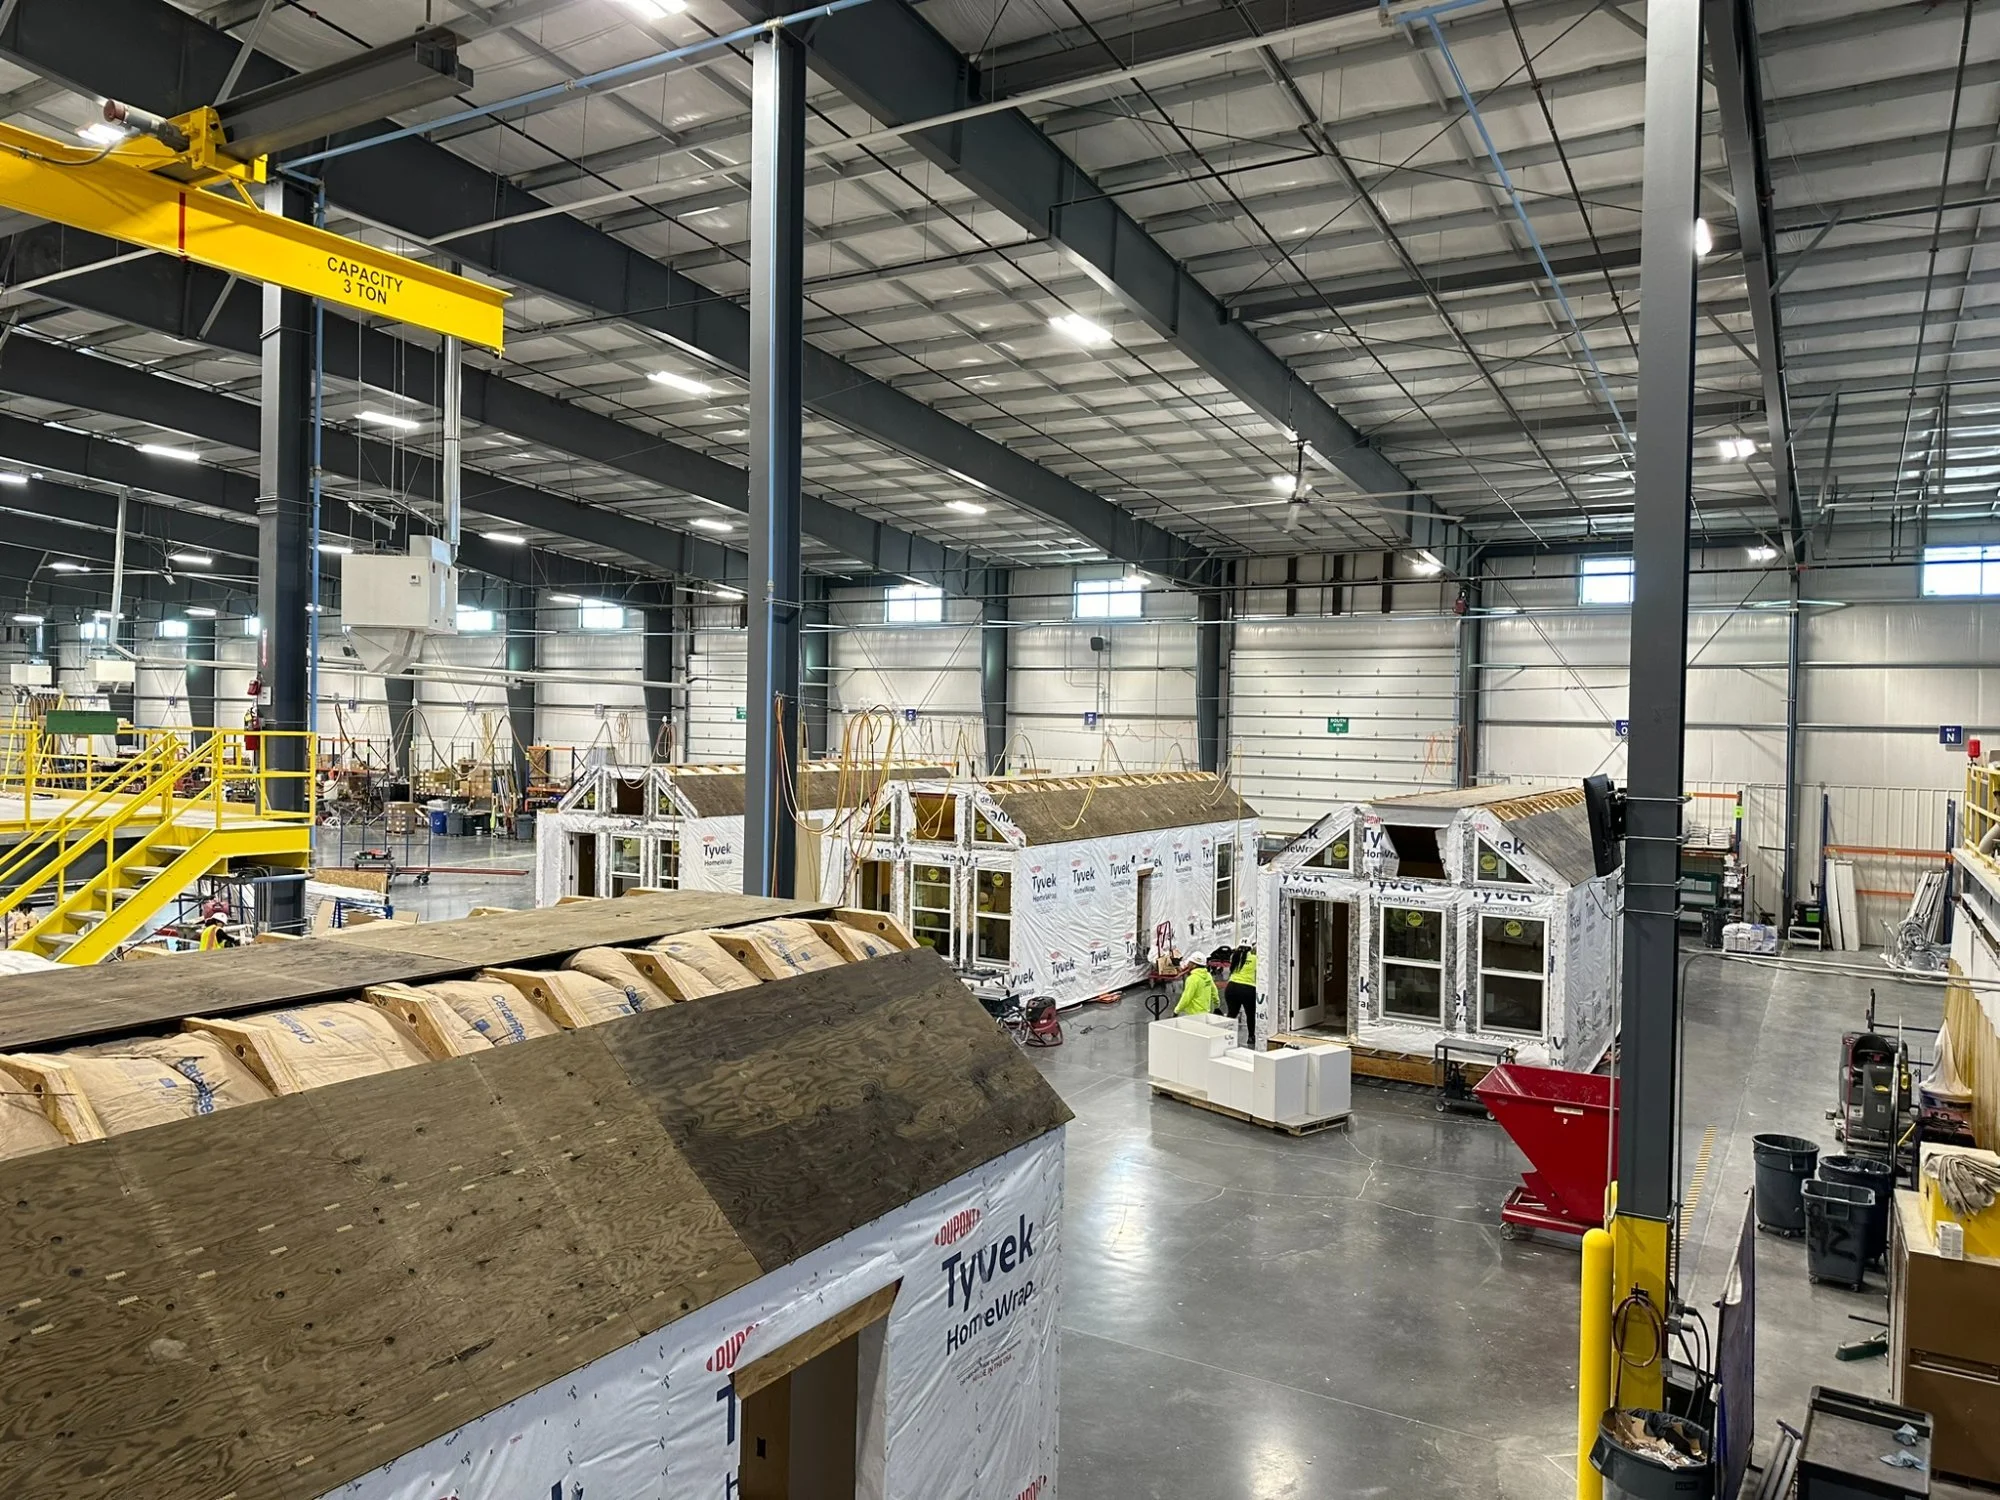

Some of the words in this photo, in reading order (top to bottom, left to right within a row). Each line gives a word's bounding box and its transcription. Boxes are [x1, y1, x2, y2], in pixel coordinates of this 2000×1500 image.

[327, 257, 403, 292] CAPACITY
[343, 279, 351, 293] 3
[357, 282, 387, 305] TON
[1946, 733, 1955, 742] N
[703, 843, 732, 859] Tyvek
[1072, 867, 1096, 885] Tyvek
[1110, 861, 1131, 878] Tyvek
[1032, 873, 1057, 893] Tyvek
[1090, 947, 1111, 966] Tyvek
[1052, 957, 1075, 978] Tyvek
[938, 1208, 979, 1246] DUPONT
[942, 1214, 1034, 1313] Tyvek
[947, 1280, 1034, 1356] HomeWrap
